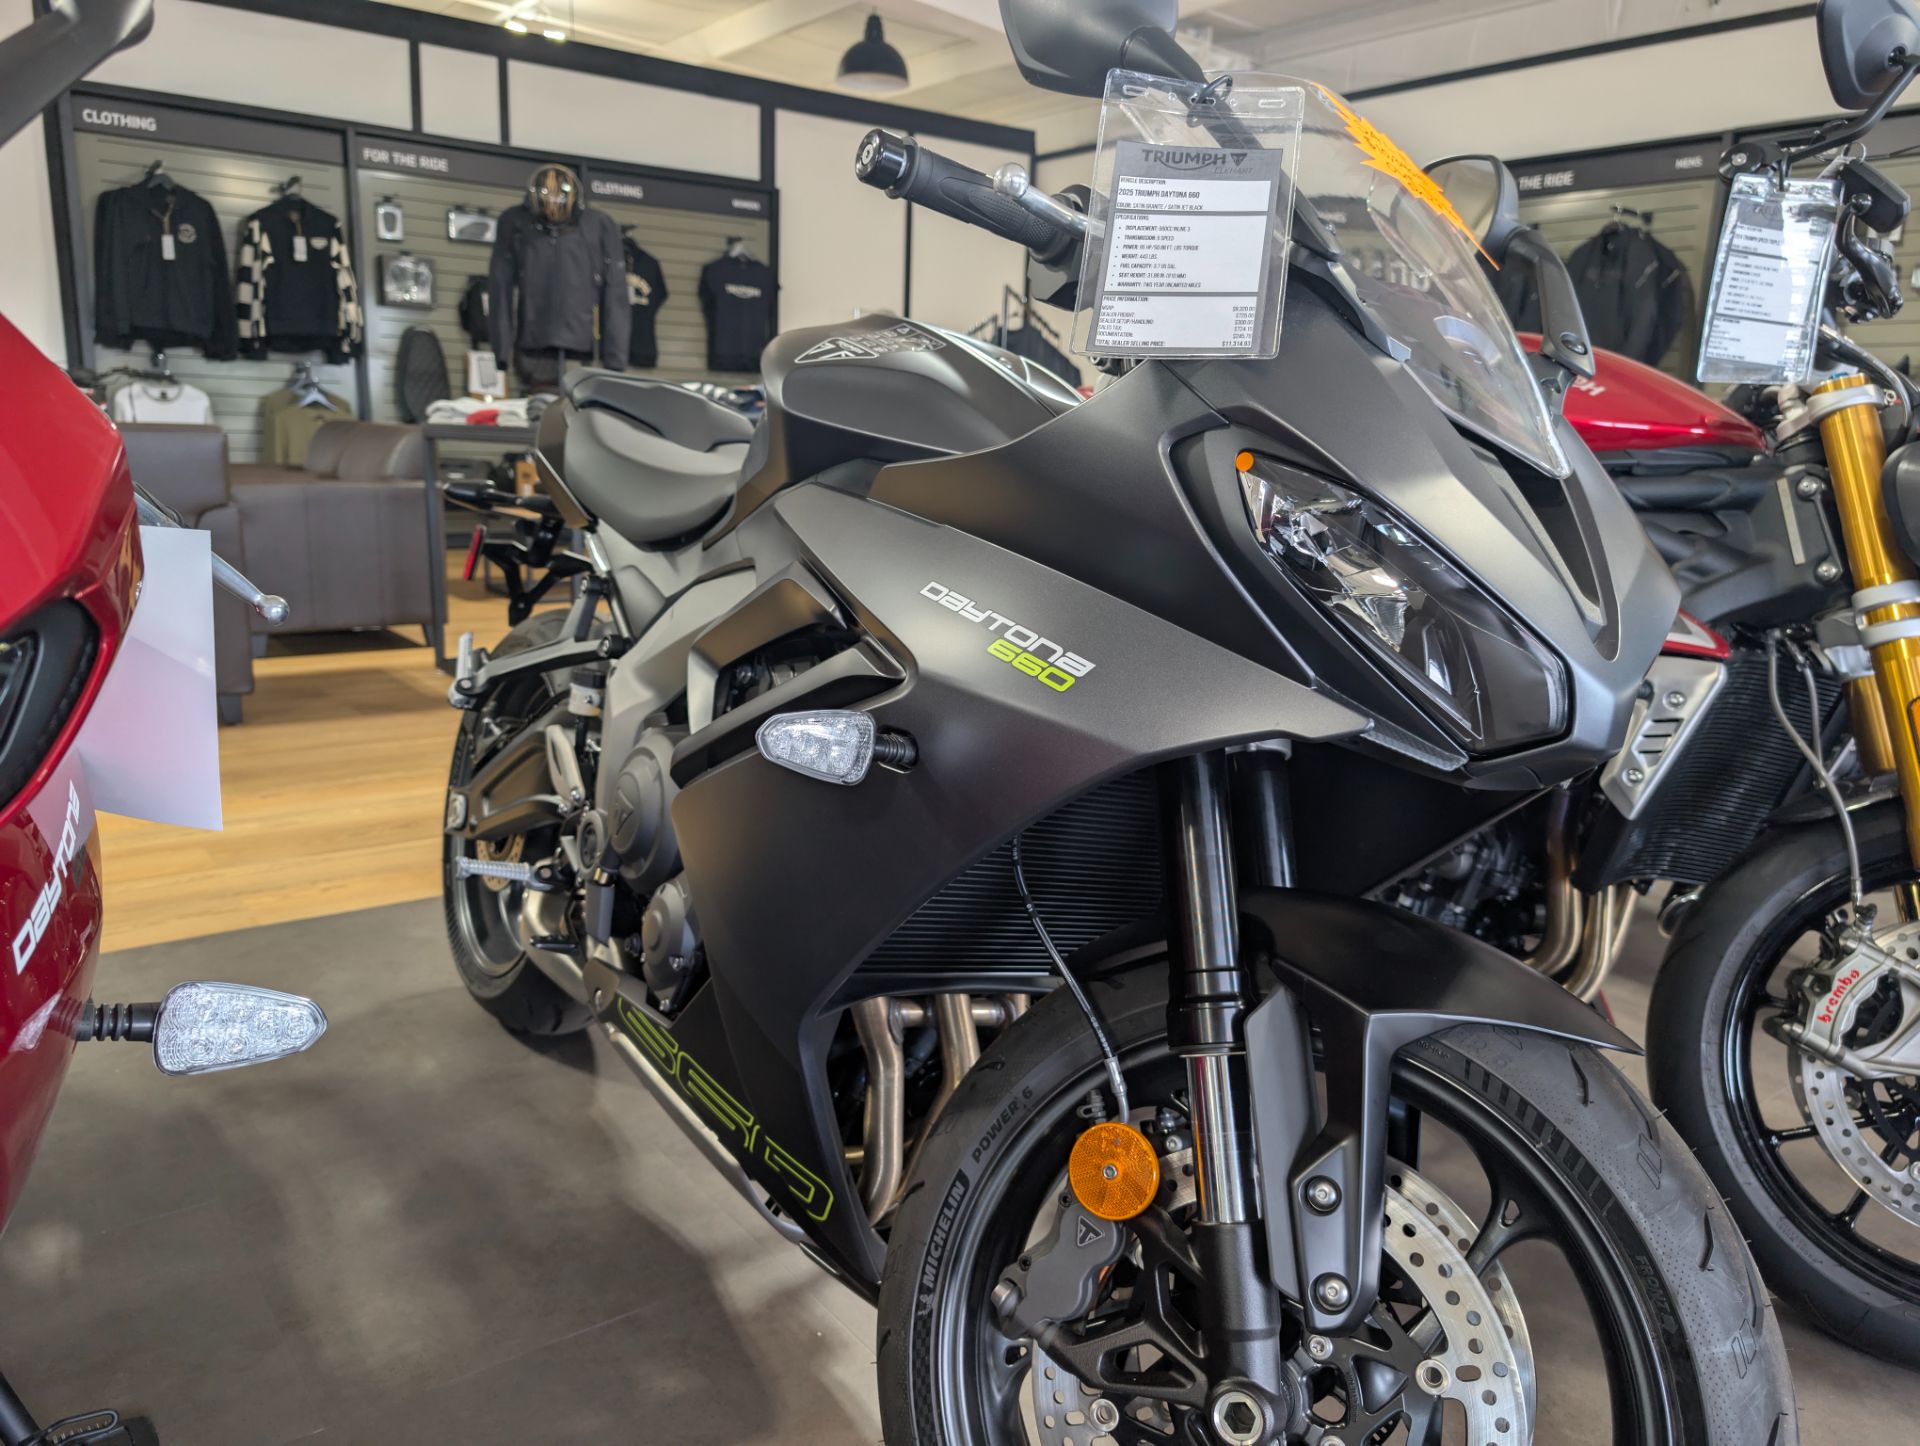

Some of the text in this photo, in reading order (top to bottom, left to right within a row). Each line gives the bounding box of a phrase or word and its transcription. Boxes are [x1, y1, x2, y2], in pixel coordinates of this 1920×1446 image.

[82, 108, 157, 132] CLOTHING
[362, 147, 449, 172] FOR THE RIDE
[1142, 149, 1227, 170] TRIUMPH
[1675, 155, 1704, 169] MENS
[591, 180, 644, 199] CLOTHING
[1519, 170, 1575, 190] THE RIDE
[1118, 188, 1133, 196] 2025
[1135, 189, 1160, 197] TRIUMPH
[986, 639, 1076, 692] 660
[1816, 969, 1860, 1024] brembo
[920, 1179, 967, 1288] MICHELIN
[971, 1100, 1020, 1164] POWER
